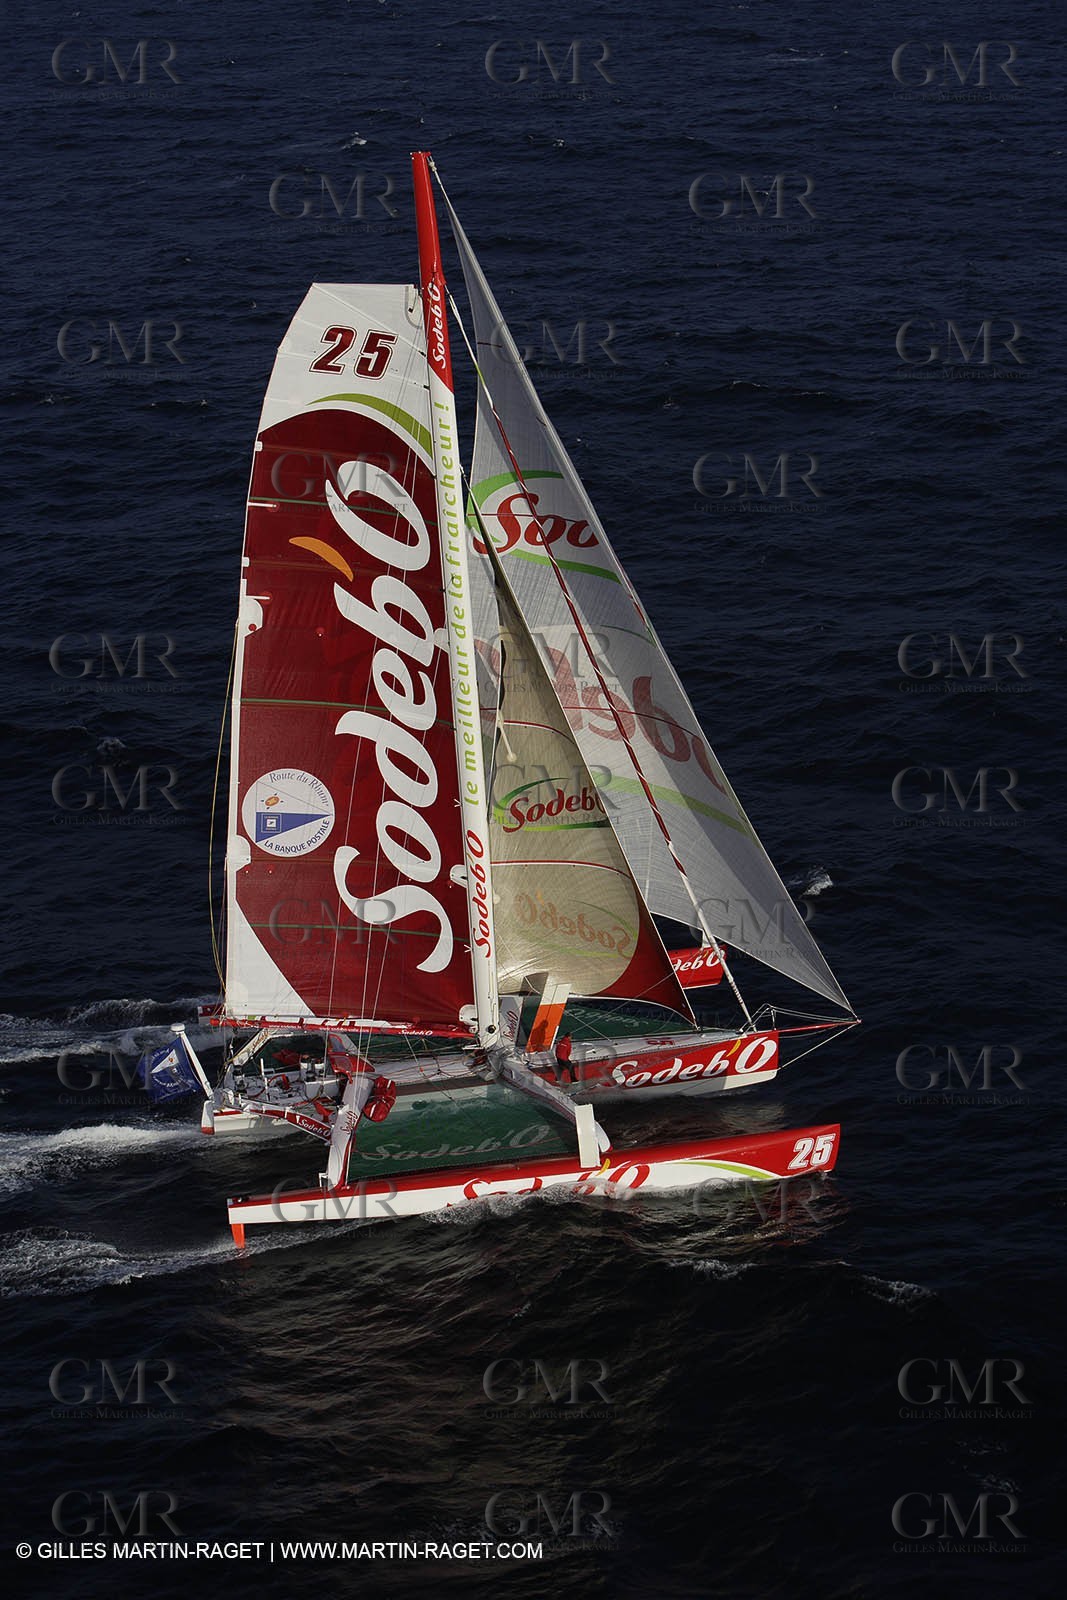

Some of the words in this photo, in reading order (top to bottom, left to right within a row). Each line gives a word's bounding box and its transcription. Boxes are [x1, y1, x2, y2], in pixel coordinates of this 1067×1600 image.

[309, 324, 399, 380] 25
[450, 606, 466, 639] de
[456, 647, 476, 770] meilleur
[268, 772, 296, 783] Route
[297, 772, 308, 783] du
[464, 781, 479, 805] le
[264, 840, 274, 849] LA
[274, 843, 306, 854] BANQUE
[307, 819, 330, 847] POSTALE
[608, 1036, 777, 1089] Sodeb'O
[787, 1133, 836, 1170] 25
